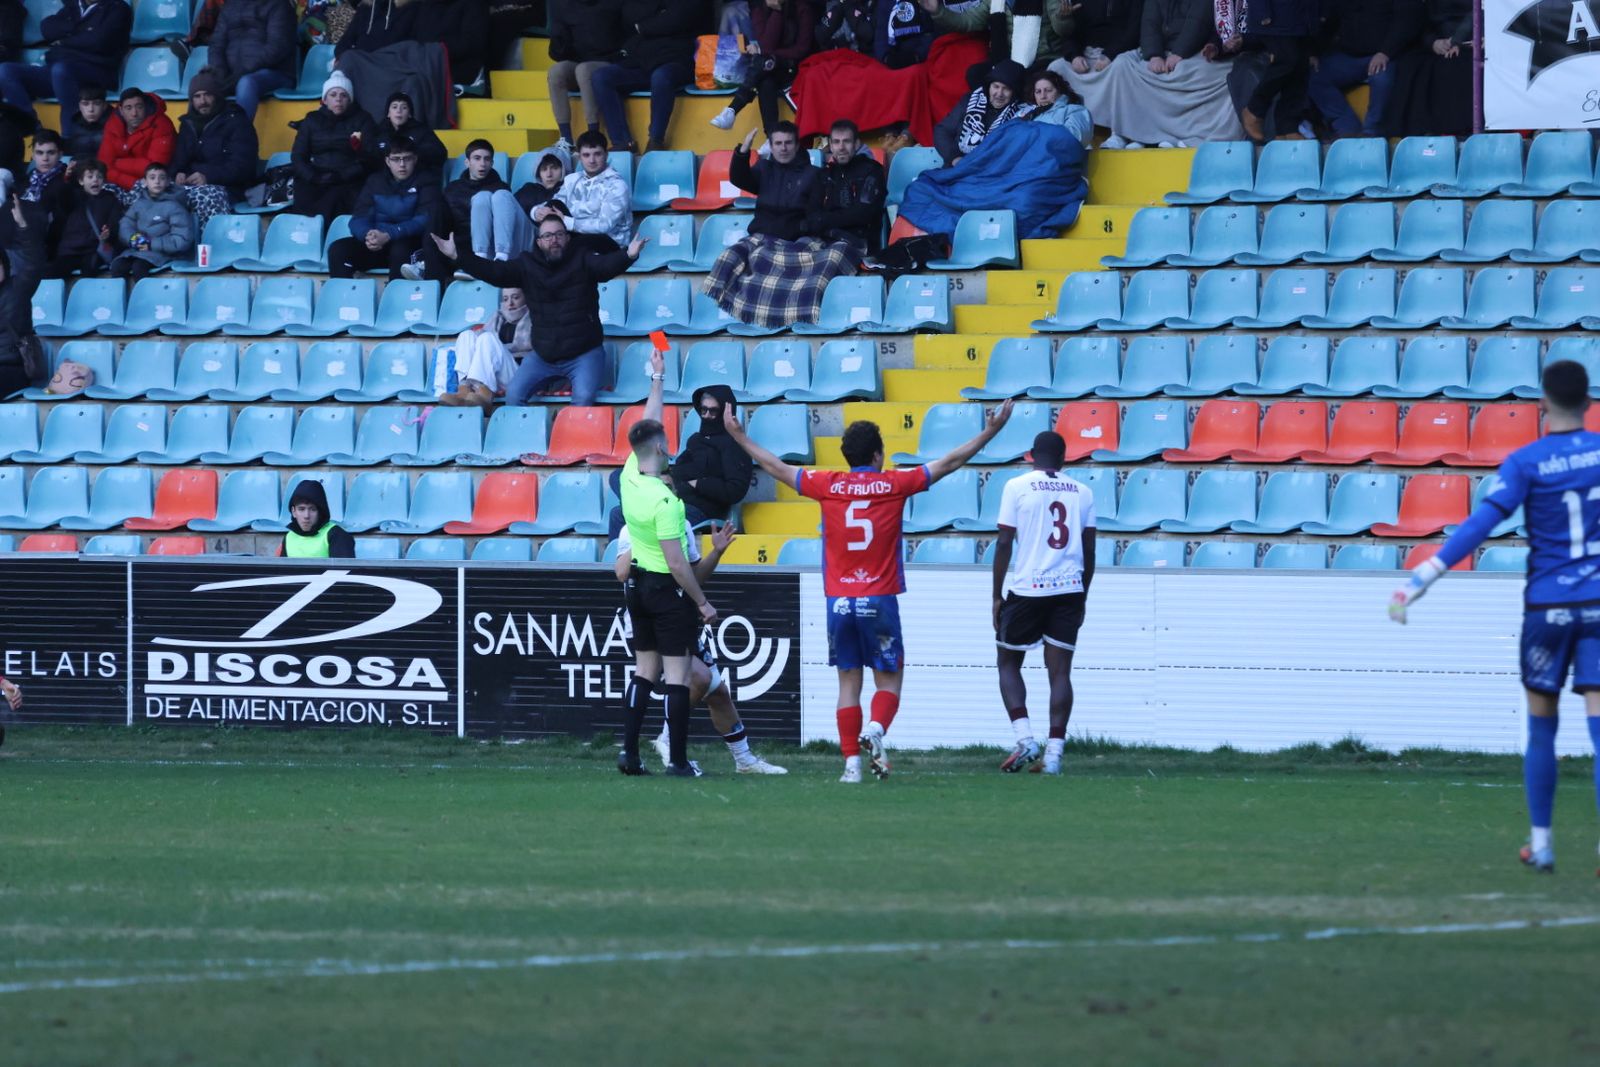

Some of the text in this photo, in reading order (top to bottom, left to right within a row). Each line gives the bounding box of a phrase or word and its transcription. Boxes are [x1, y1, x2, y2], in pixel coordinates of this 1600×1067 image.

[506, 113, 515, 126] 9
[1103, 219, 1113, 233] 8
[1036, 282, 1045, 297] 7
[881, 342, 896, 355] 55
[968, 347, 977, 361] 6
[830, 480, 892, 496] DE FRUTOS
[845, 500, 874, 551] 5
[1047, 500, 1070, 550] 3
[5, 650, 117, 678] ELAIS
[147, 651, 446, 688] DISCOSA
[146, 697, 449, 727] DE ALIMENTACION, S.L.
